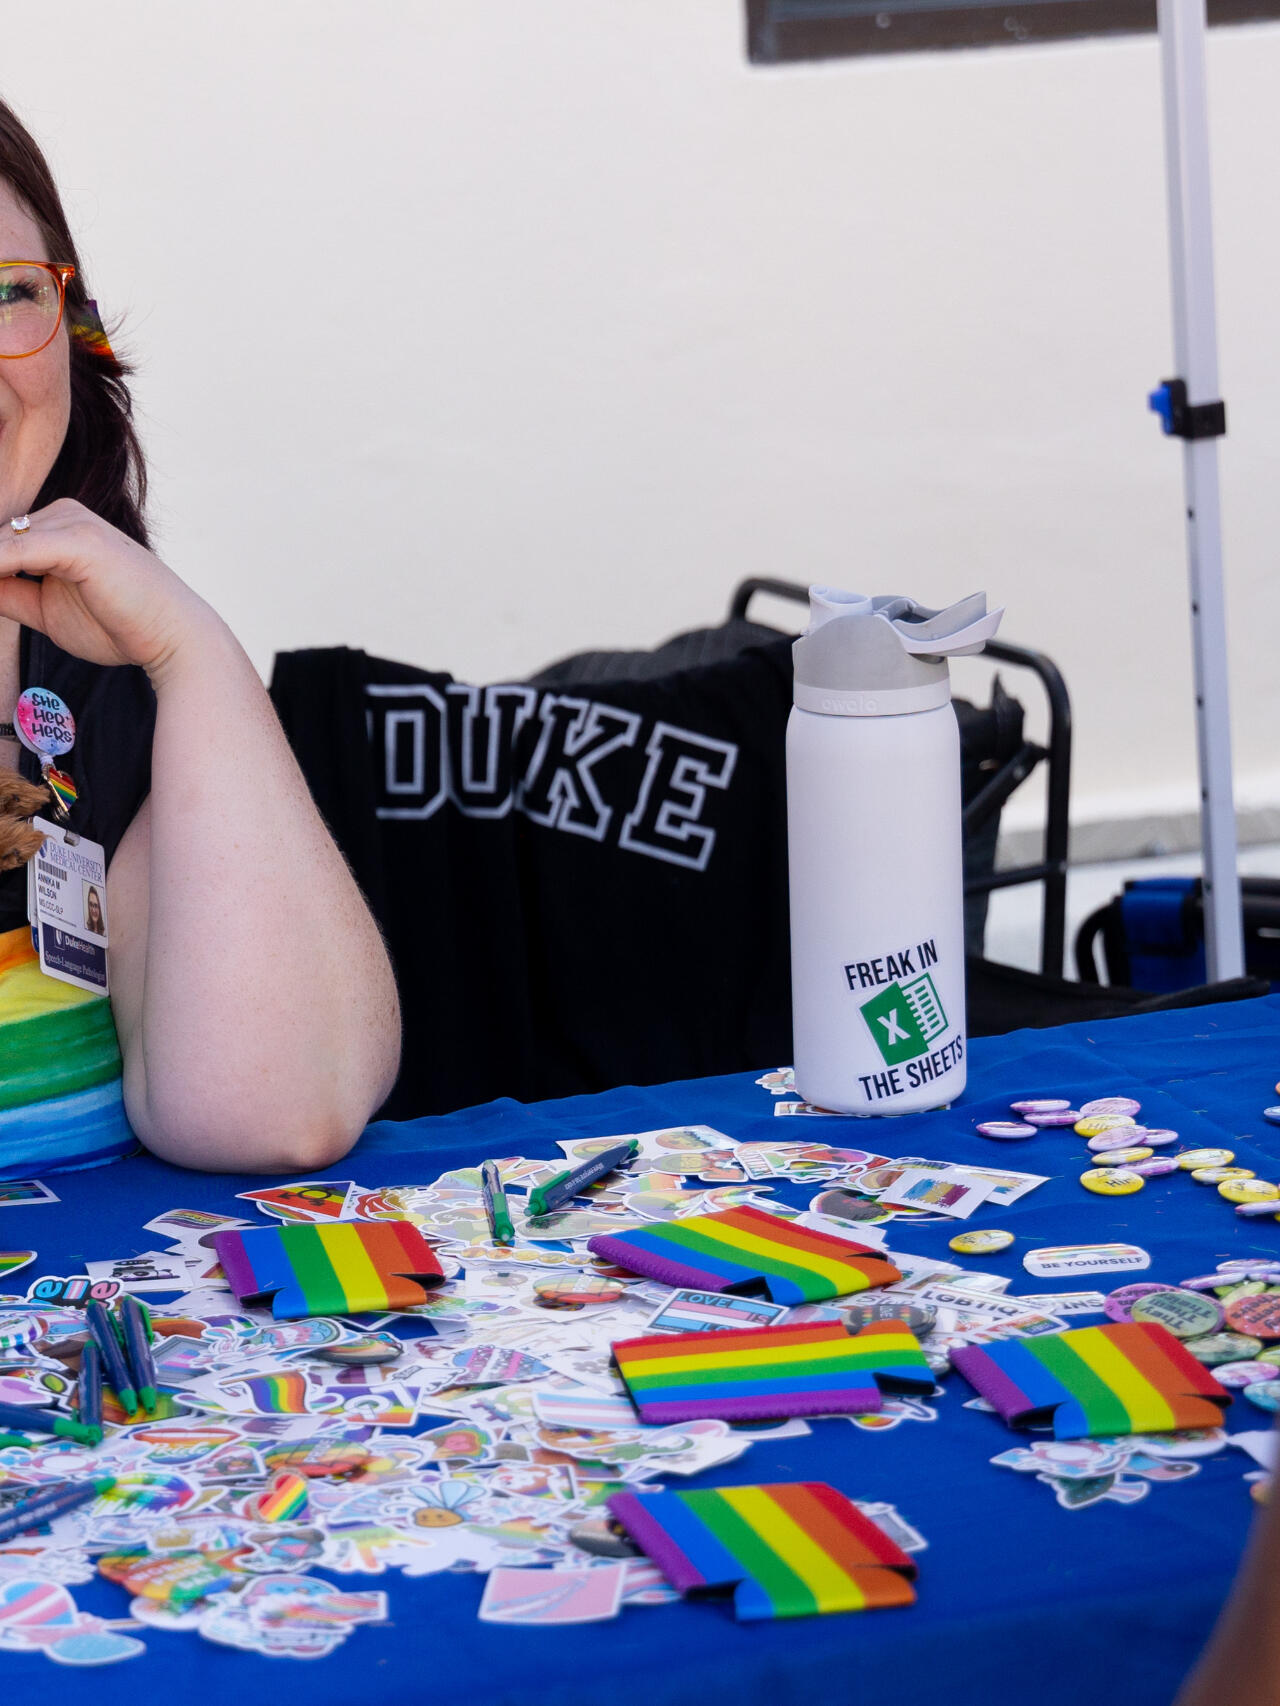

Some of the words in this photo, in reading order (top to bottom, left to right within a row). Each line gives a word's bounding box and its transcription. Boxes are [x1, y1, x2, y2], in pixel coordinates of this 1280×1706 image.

[366, 684, 738, 871] DUKE
[49, 842, 67, 857] DUKE
[68, 850, 103, 873] UNIVERSITY
[50, 852, 77, 872] MEDICAL
[78, 865, 103, 883] CENTER
[39, 884, 57, 900] WILSON
[844, 949, 915, 990] FREAK
[917, 939, 938, 969] IN
[877, 1008, 911, 1046] X
[858, 1068, 904, 1101] THE
[906, 1035, 963, 1088] SHEETS
[1041, 1261, 1062, 1269] BE
[1064, 1257, 1143, 1268] YOURSELF
[677, 1291, 731, 1308] LOVE
[749, 1312, 770, 1323] IS
